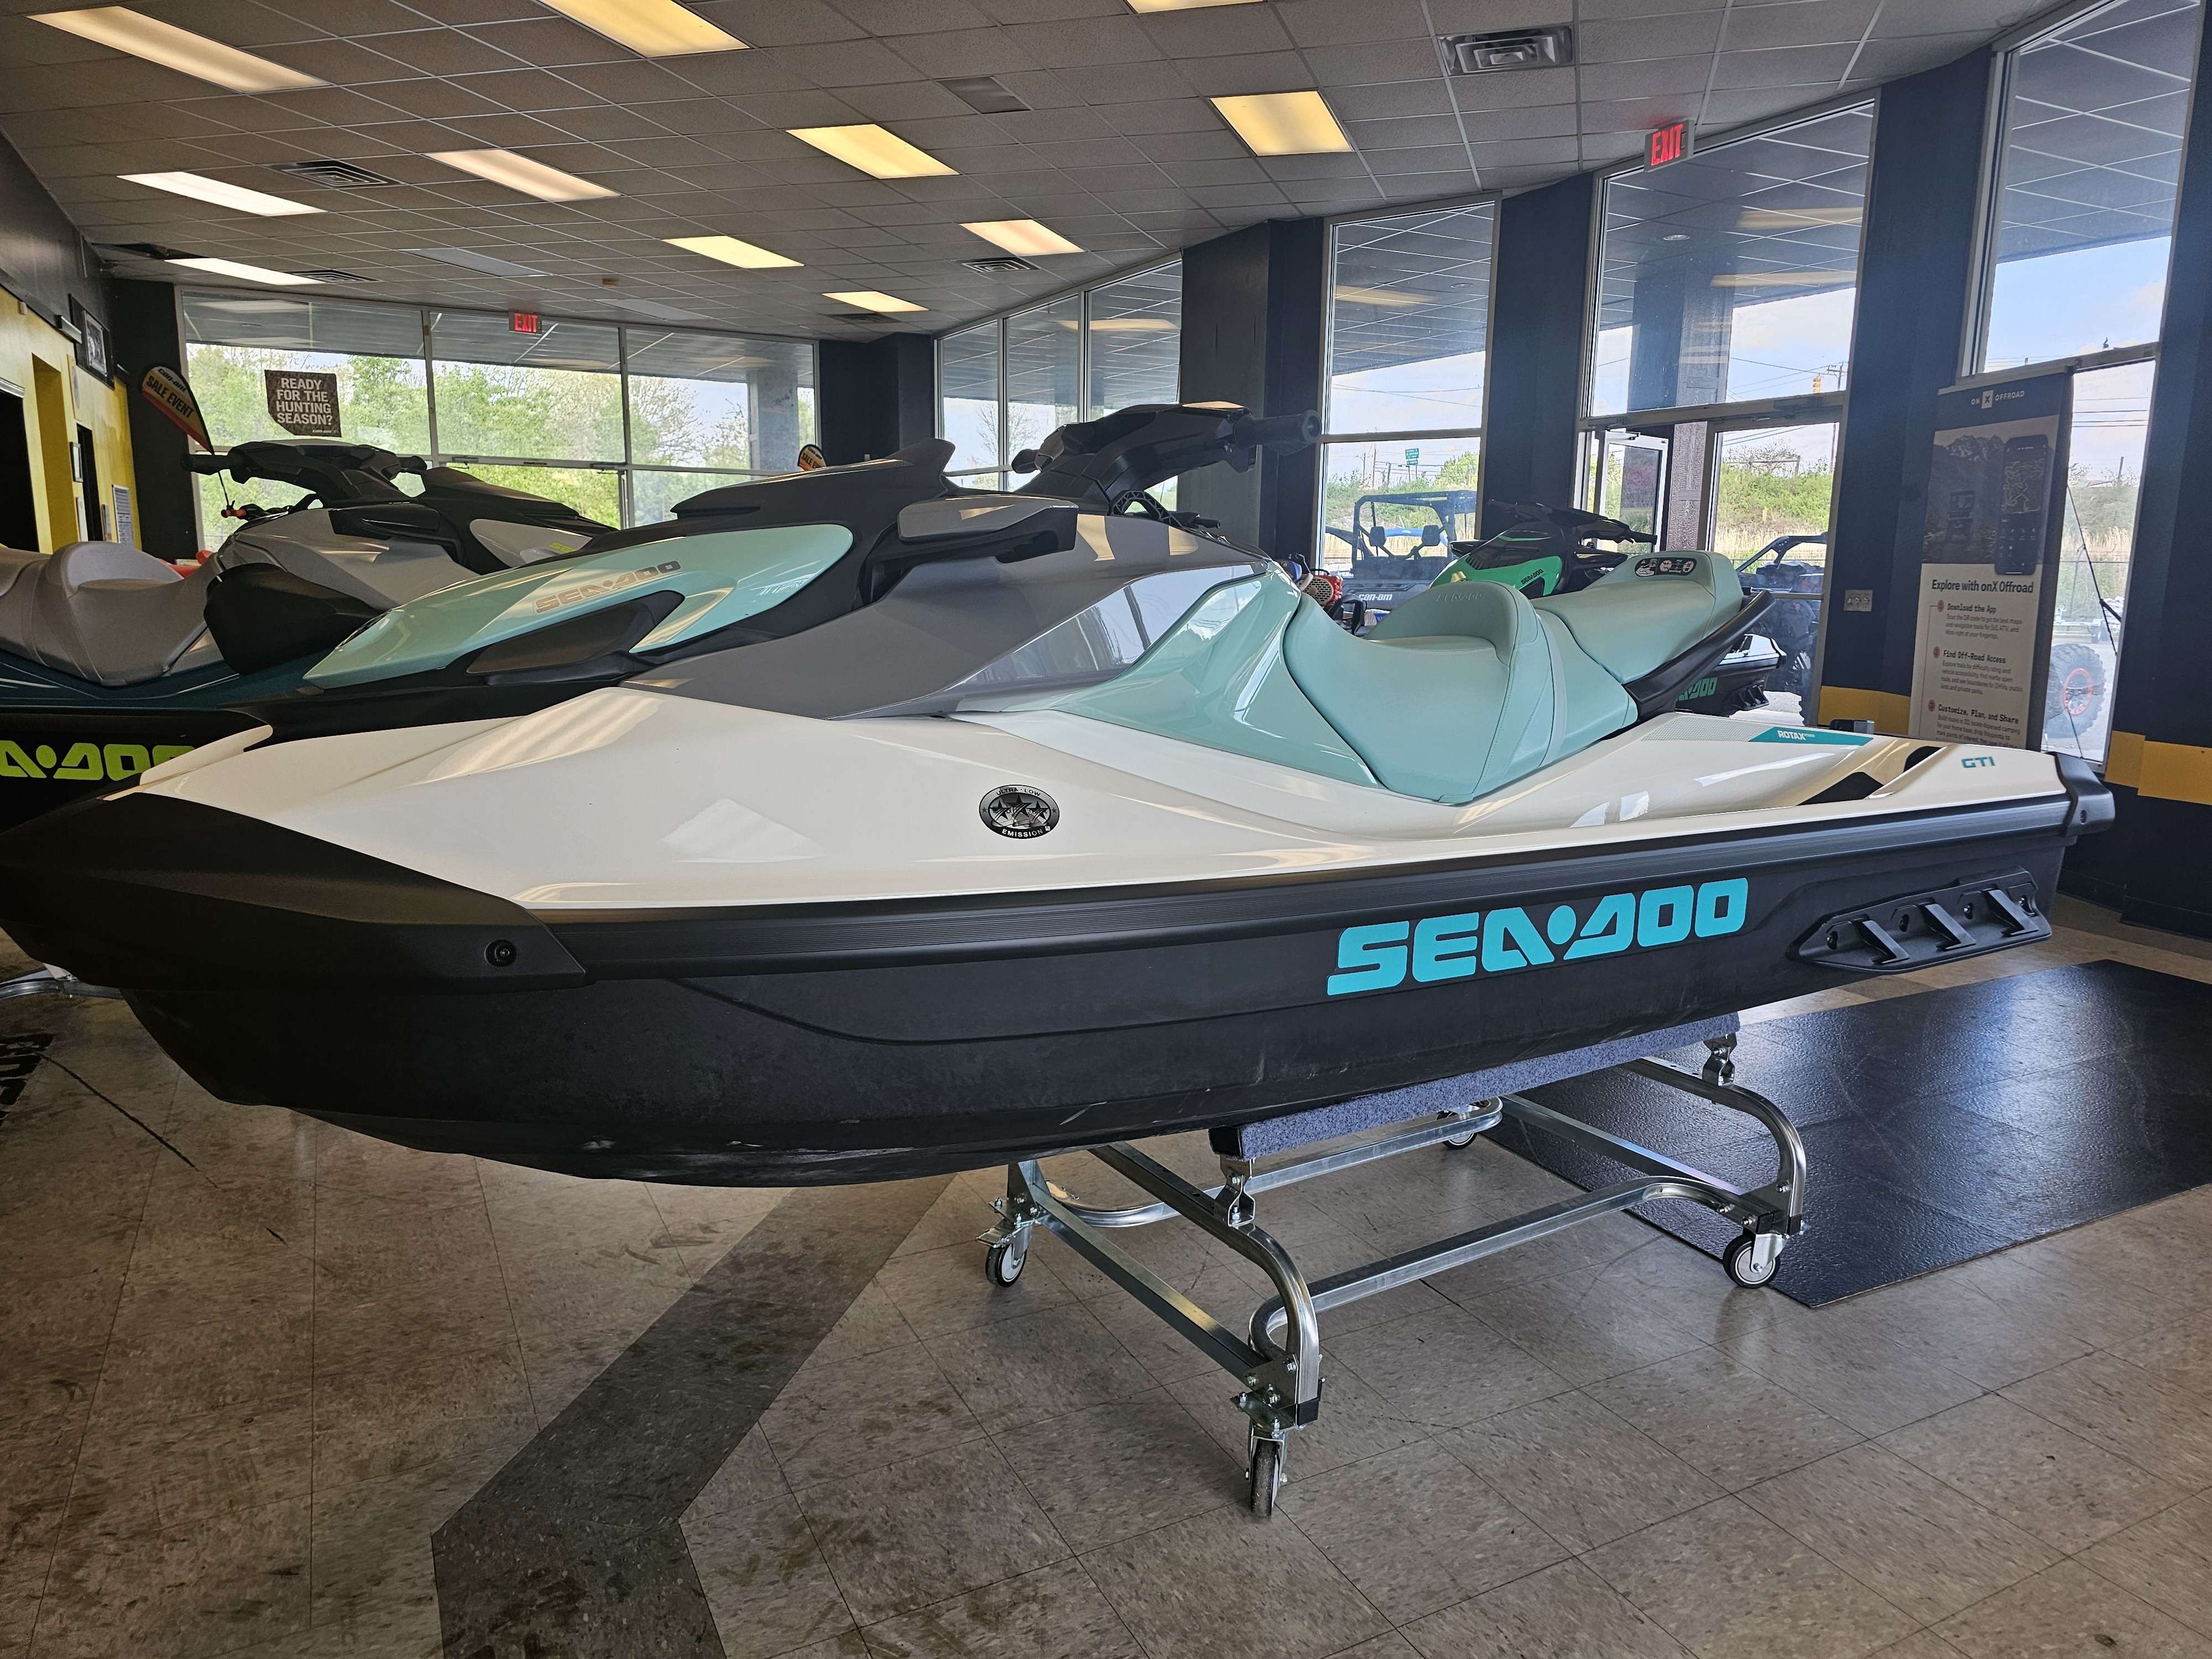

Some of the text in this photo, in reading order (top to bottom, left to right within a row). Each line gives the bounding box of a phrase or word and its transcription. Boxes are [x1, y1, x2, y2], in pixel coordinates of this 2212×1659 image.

[1651, 124, 1683, 166] EXIT
[515, 314, 538, 332] EXIT
[158, 368, 186, 392] can-am
[281, 378, 322, 390] READY
[147, 376, 195, 418] SALE EVENT
[276, 389, 328, 402] FOR THE
[1995, 390, 2025, 401] OFFROAD
[276, 401, 331, 414] HUNTING
[277, 413, 333, 425] SEASON?
[1932, 579, 2034, 593] Explore with onX Offroad
[1947, 603, 1973, 612] Download
[1986, 605, 1996, 614] App
[1943, 650, 2006, 664] Find Off-Road Access
[1938, 704, 1969, 716] Customize,
[1971, 709, 1986, 719] Plan,
[2000, 714, 2019, 724] Share
[1777, 730, 1806, 740] ROTAX
[1961, 757, 1995, 768] GTI
[996, 787, 1041, 796] ULTRA LOW
[1001, 828, 1043, 837] EMISSION
